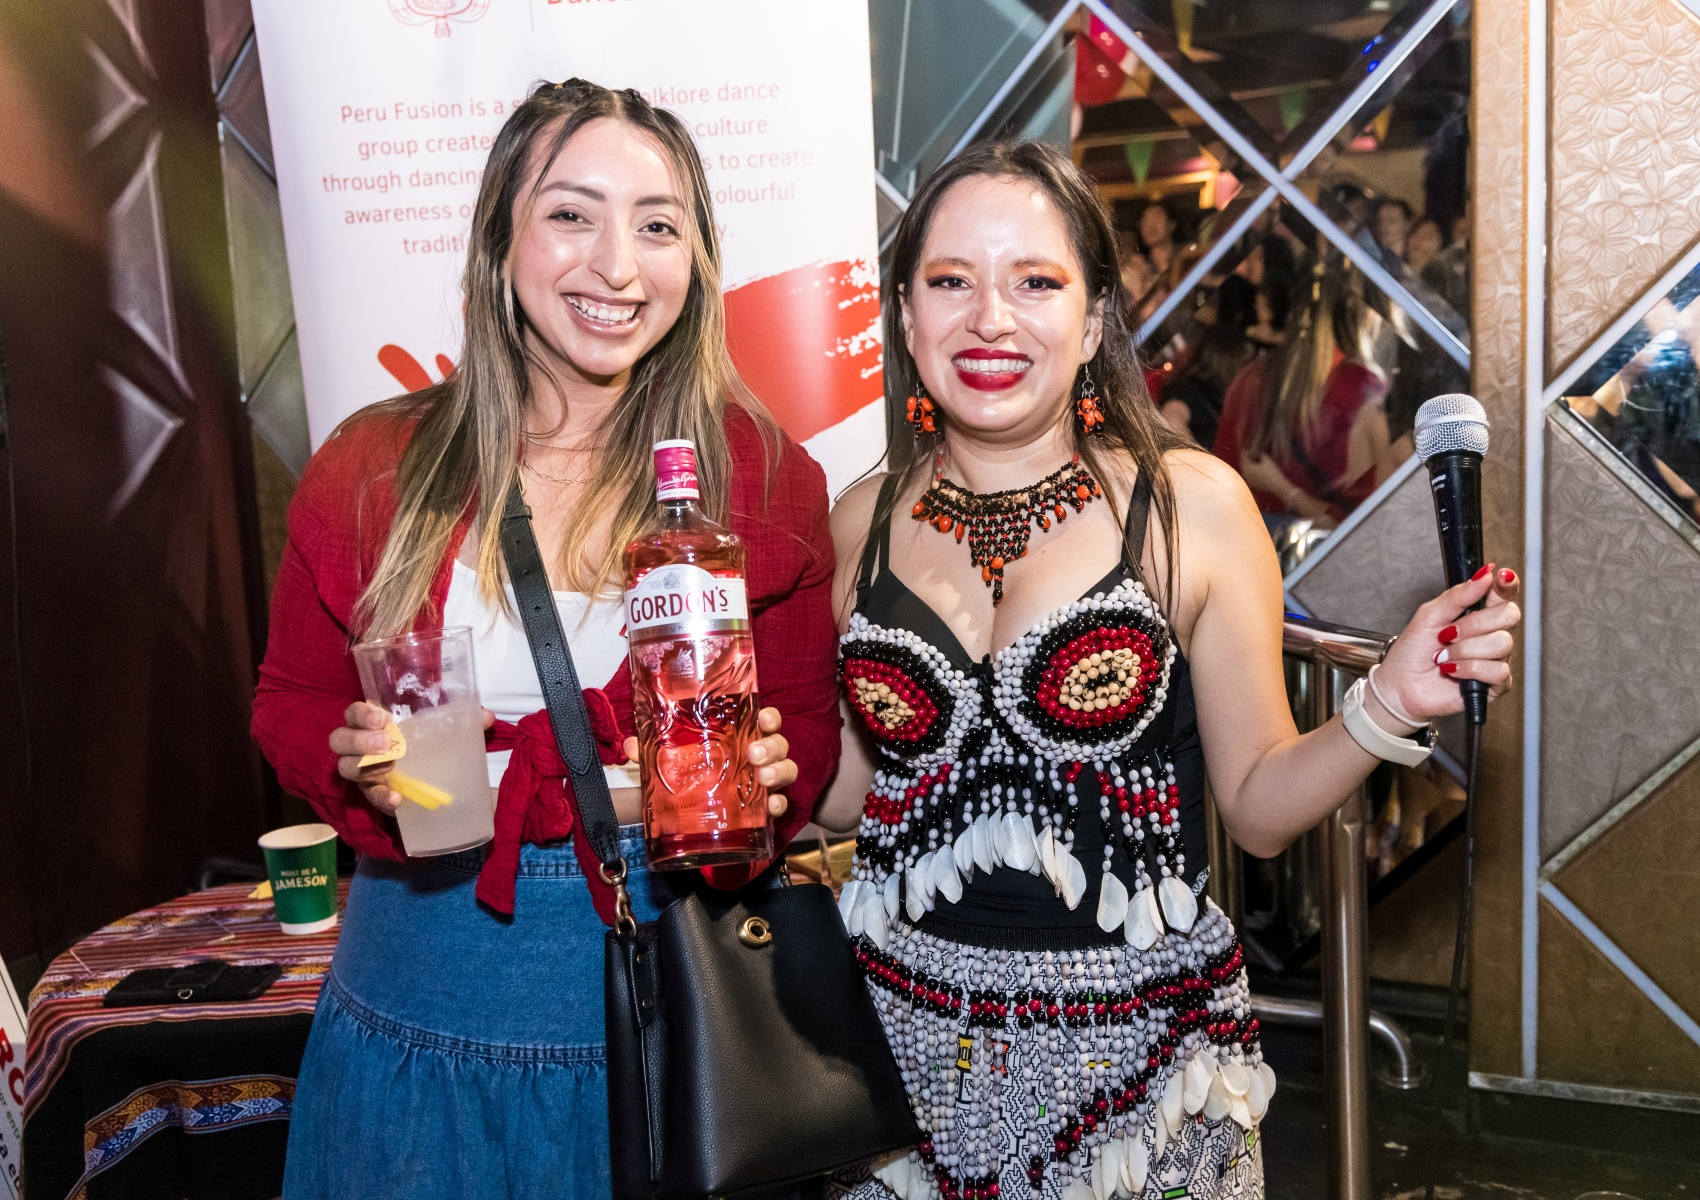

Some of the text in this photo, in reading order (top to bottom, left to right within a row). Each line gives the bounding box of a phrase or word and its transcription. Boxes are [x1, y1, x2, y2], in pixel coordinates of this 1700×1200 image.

[635, 83, 780, 106] olklore dance
[341, 105, 387, 123] Peru
[394, 100, 463, 120] Fusion
[469, 98, 486, 116] is
[493, 100, 504, 115] a
[695, 117, 768, 138] culture
[358, 139, 419, 161] group
[719, 154, 740, 170] to
[747, 149, 813, 169] create
[322, 170, 401, 194] through
[710, 181, 796, 205] olourful
[344, 204, 453, 225] awareness
[403, 233, 470, 255] traditi
[630, 586, 728, 624] GORDON'S
[275, 875, 328, 891] JAMESON
[280, 869, 300, 877] MUST
[301, 868, 310, 876] BE
